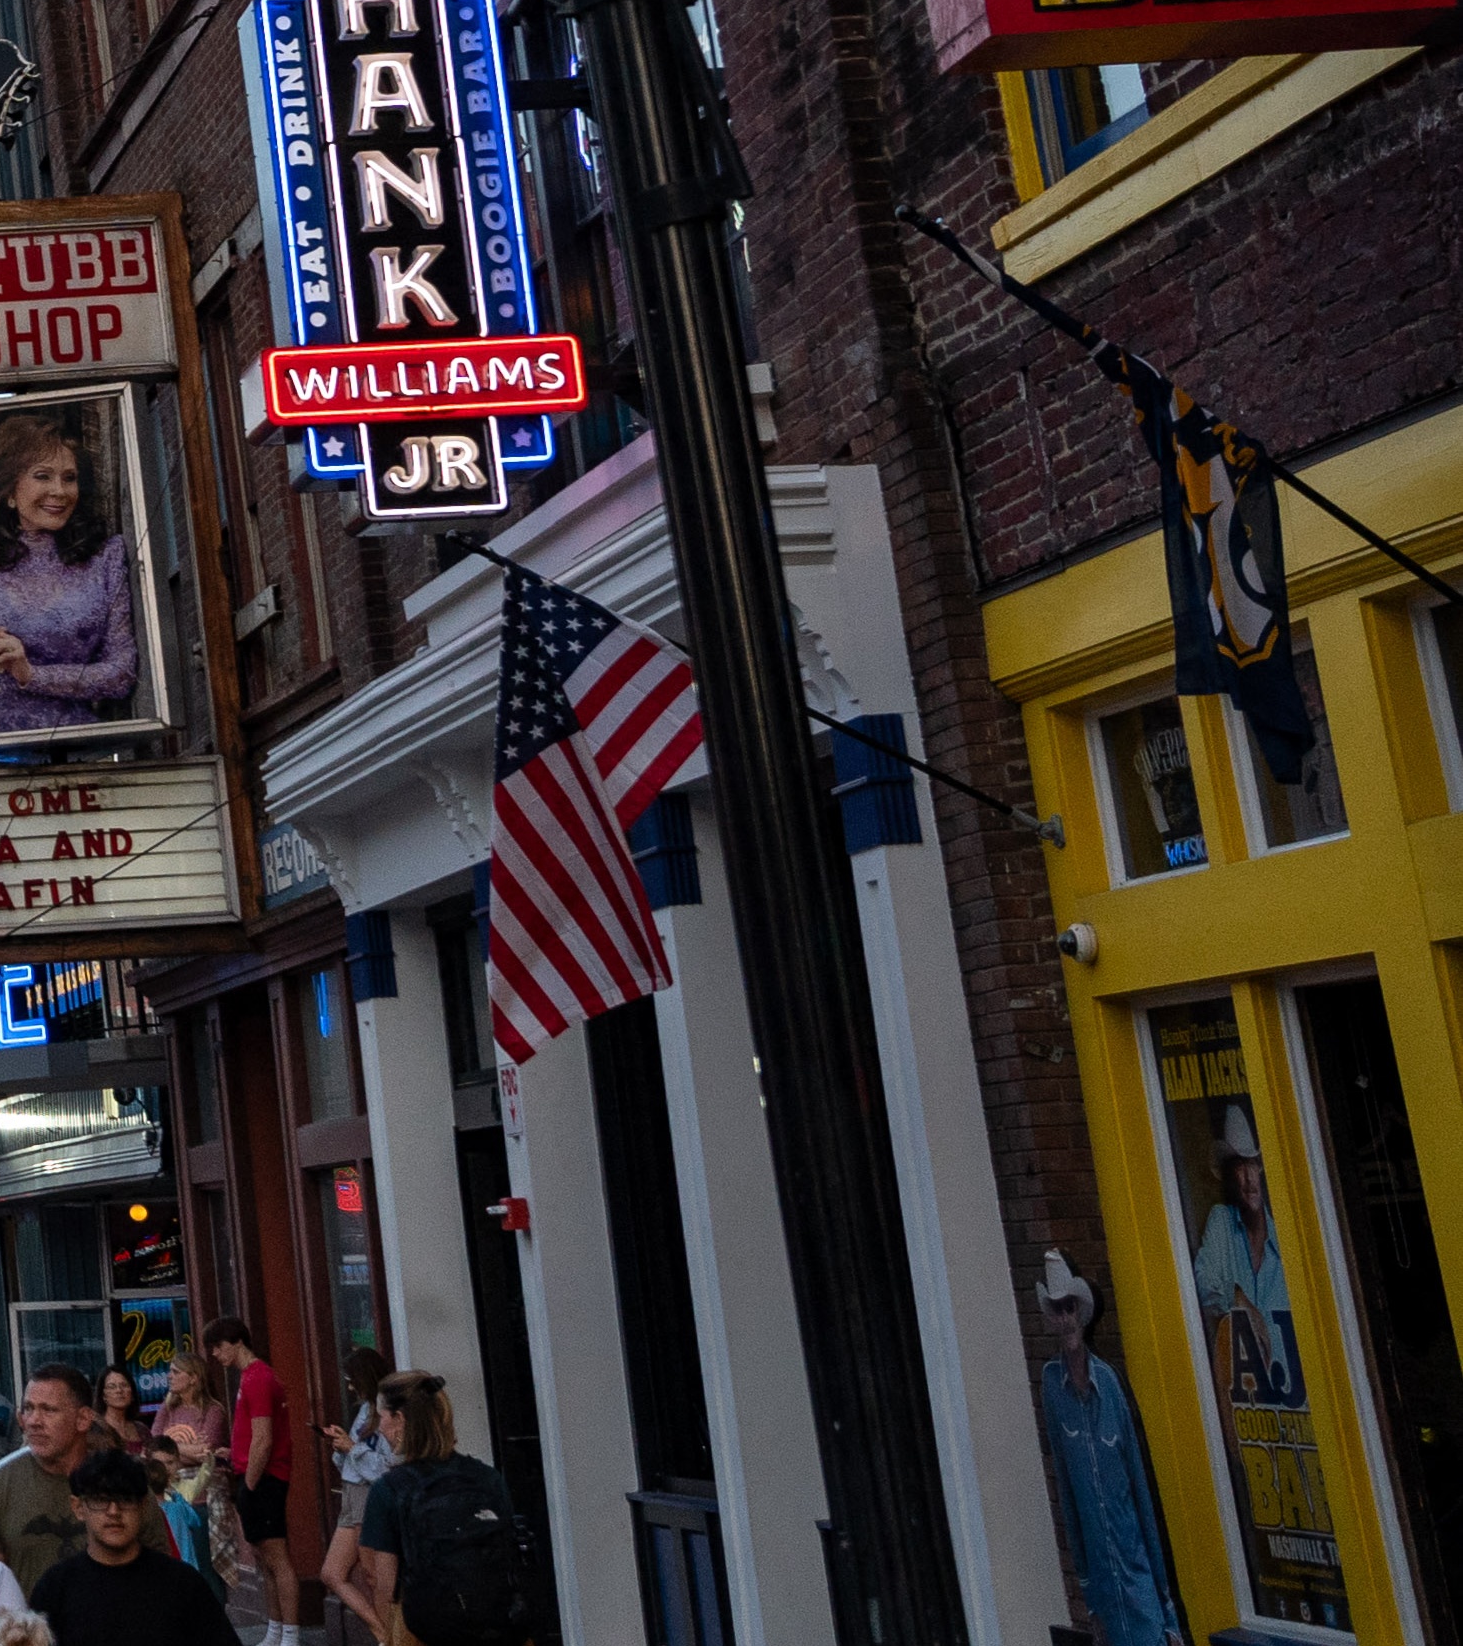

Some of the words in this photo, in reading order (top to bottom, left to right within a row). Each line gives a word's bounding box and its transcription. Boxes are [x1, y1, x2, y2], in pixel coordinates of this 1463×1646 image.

[275, 31, 318, 168] DRINK
[457, 25, 491, 108] BAR
[468, 122, 518, 298] BOOGIE
[302, 217, 332, 305] EAT
[285, 350, 568, 405] WILLIAMS
[384, 432, 490, 496] JR
[51, 827, 135, 861] AND
[262, 829, 325, 895] RECOR
